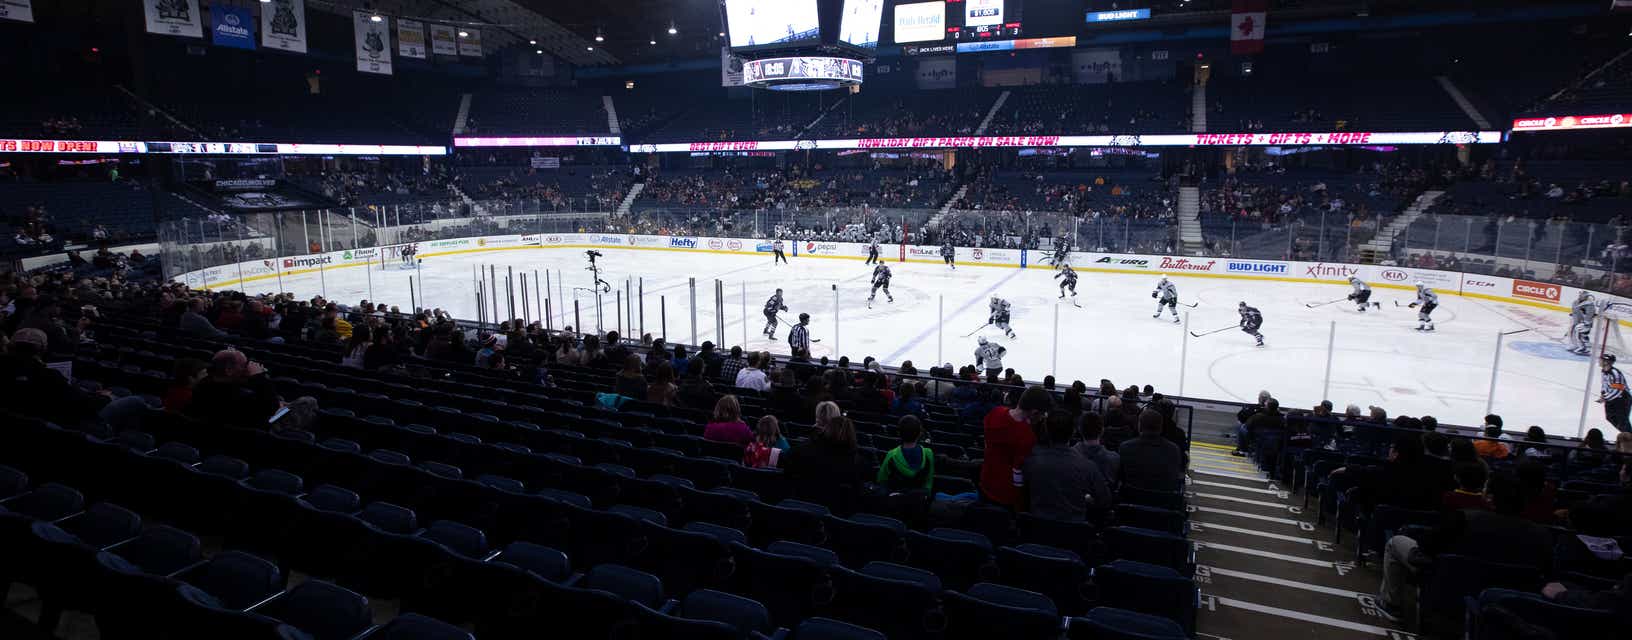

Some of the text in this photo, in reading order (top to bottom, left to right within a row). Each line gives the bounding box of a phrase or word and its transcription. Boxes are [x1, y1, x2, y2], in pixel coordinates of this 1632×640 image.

[1114, 12, 1138, 20] LIGHT
[216, 24, 249, 36] Allstate
[857, 135, 1060, 148] HOWLIDAY GIFT PACKS ON SALE NOW!
[1196, 133, 1253, 145] TICKETS
[1268, 132, 1312, 144] GIFTS
[1327, 132, 1372, 144] MORE
[21, 141, 55, 152] NOW
[57, 141, 98, 152] OPEN!
[689, 141, 758, 151] BEST GIFT EVER!
[671, 237, 696, 249] Hefty
[817, 243, 838, 252] pepsi
[293, 254, 332, 268] impact
[1159, 256, 1217, 271] Butternut
[1228, 262, 1287, 273] BUD LIGHT
[1306, 263, 1360, 278] xfinity
[1385, 270, 1405, 280] KIA
[1516, 284, 1558, 298] CIRCLE K
[1288, 505, 1304, 514] C
[1195, 564, 1211, 577] G
[1357, 595, 1377, 609] G
